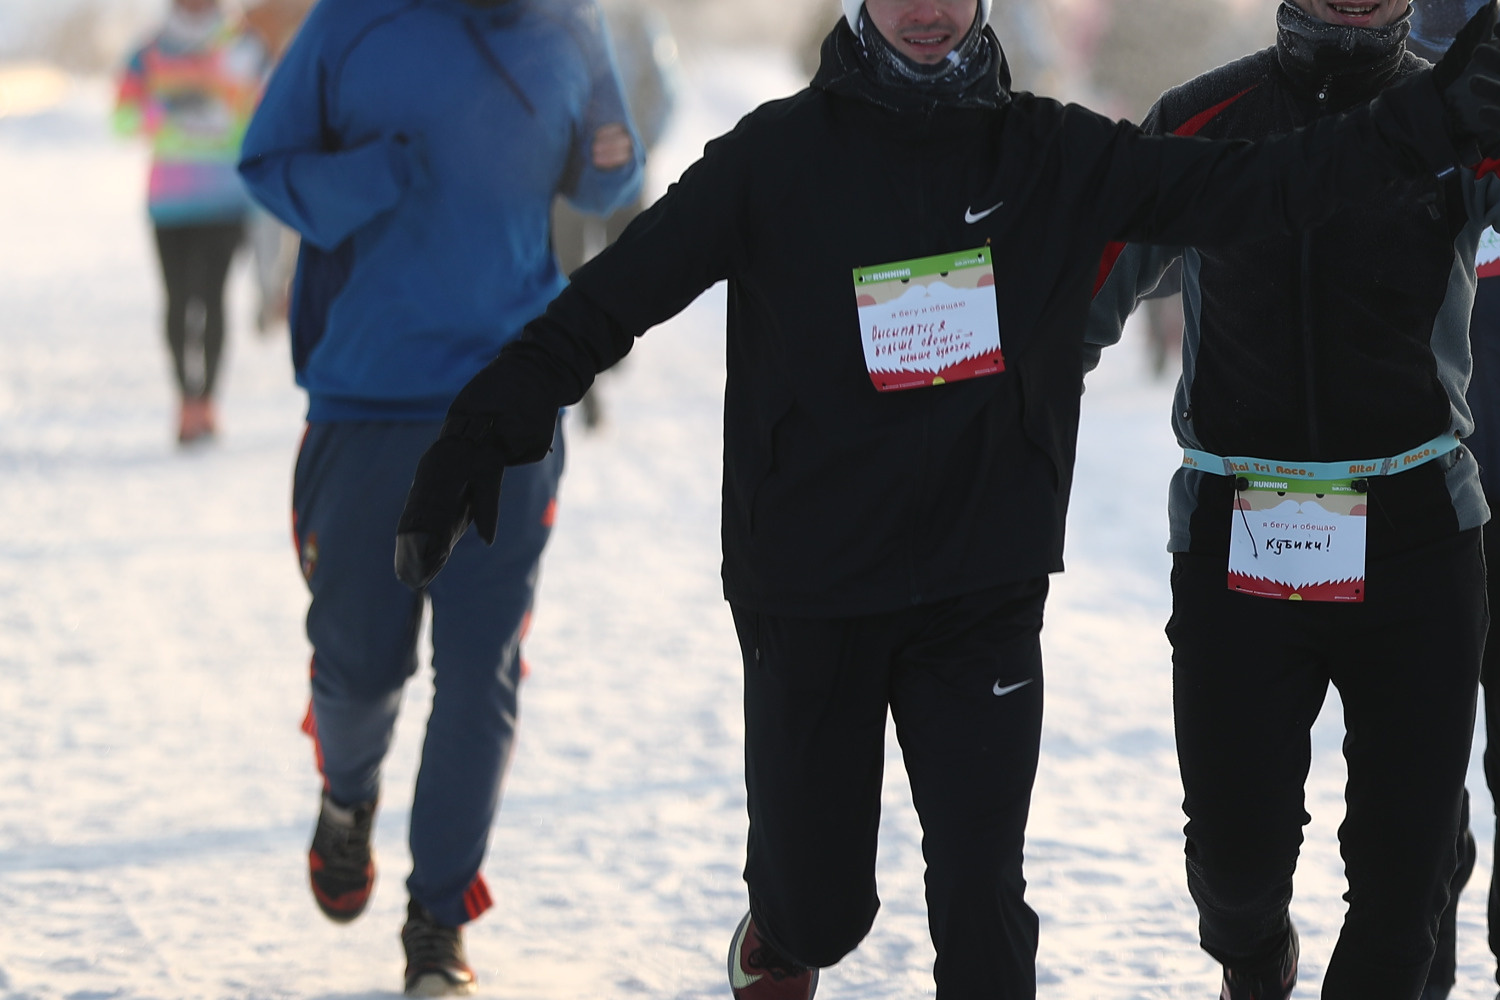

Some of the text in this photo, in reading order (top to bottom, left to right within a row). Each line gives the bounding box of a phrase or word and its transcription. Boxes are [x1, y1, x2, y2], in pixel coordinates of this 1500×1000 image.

[872, 267, 911, 281] RUNNING
[898, 308, 919, 318] бегу
[929, 300, 966, 312] обещаю
[1253, 463, 1271, 473] Tri
[1348, 463, 1376, 474] Altai
[1253, 481, 1288, 490] RUNNING
[1270, 520, 1290, 530] бегу
[1300, 522, 1336, 532] обещаю
